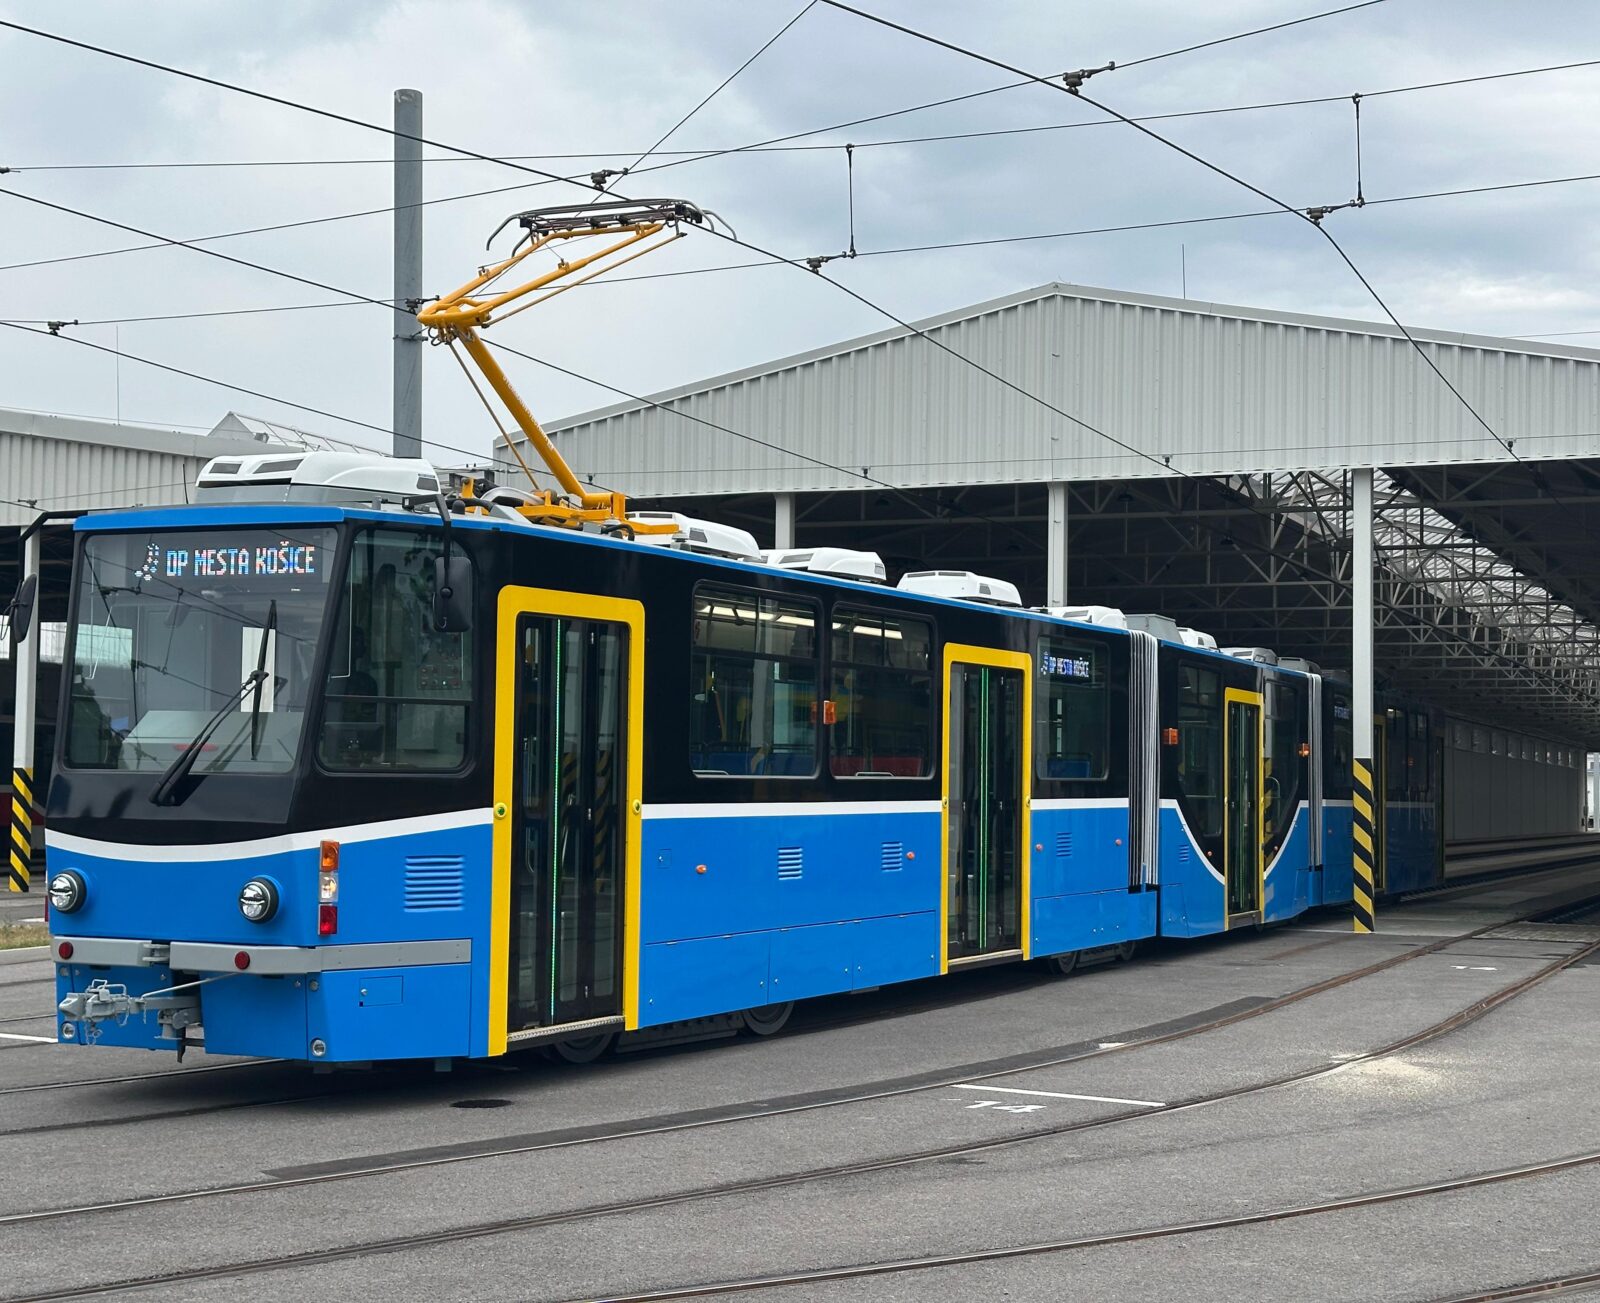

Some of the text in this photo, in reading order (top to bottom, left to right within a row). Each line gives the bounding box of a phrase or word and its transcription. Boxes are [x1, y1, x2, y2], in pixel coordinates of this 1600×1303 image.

[166, 541, 315, 576] DP MESTA KOŠICE
